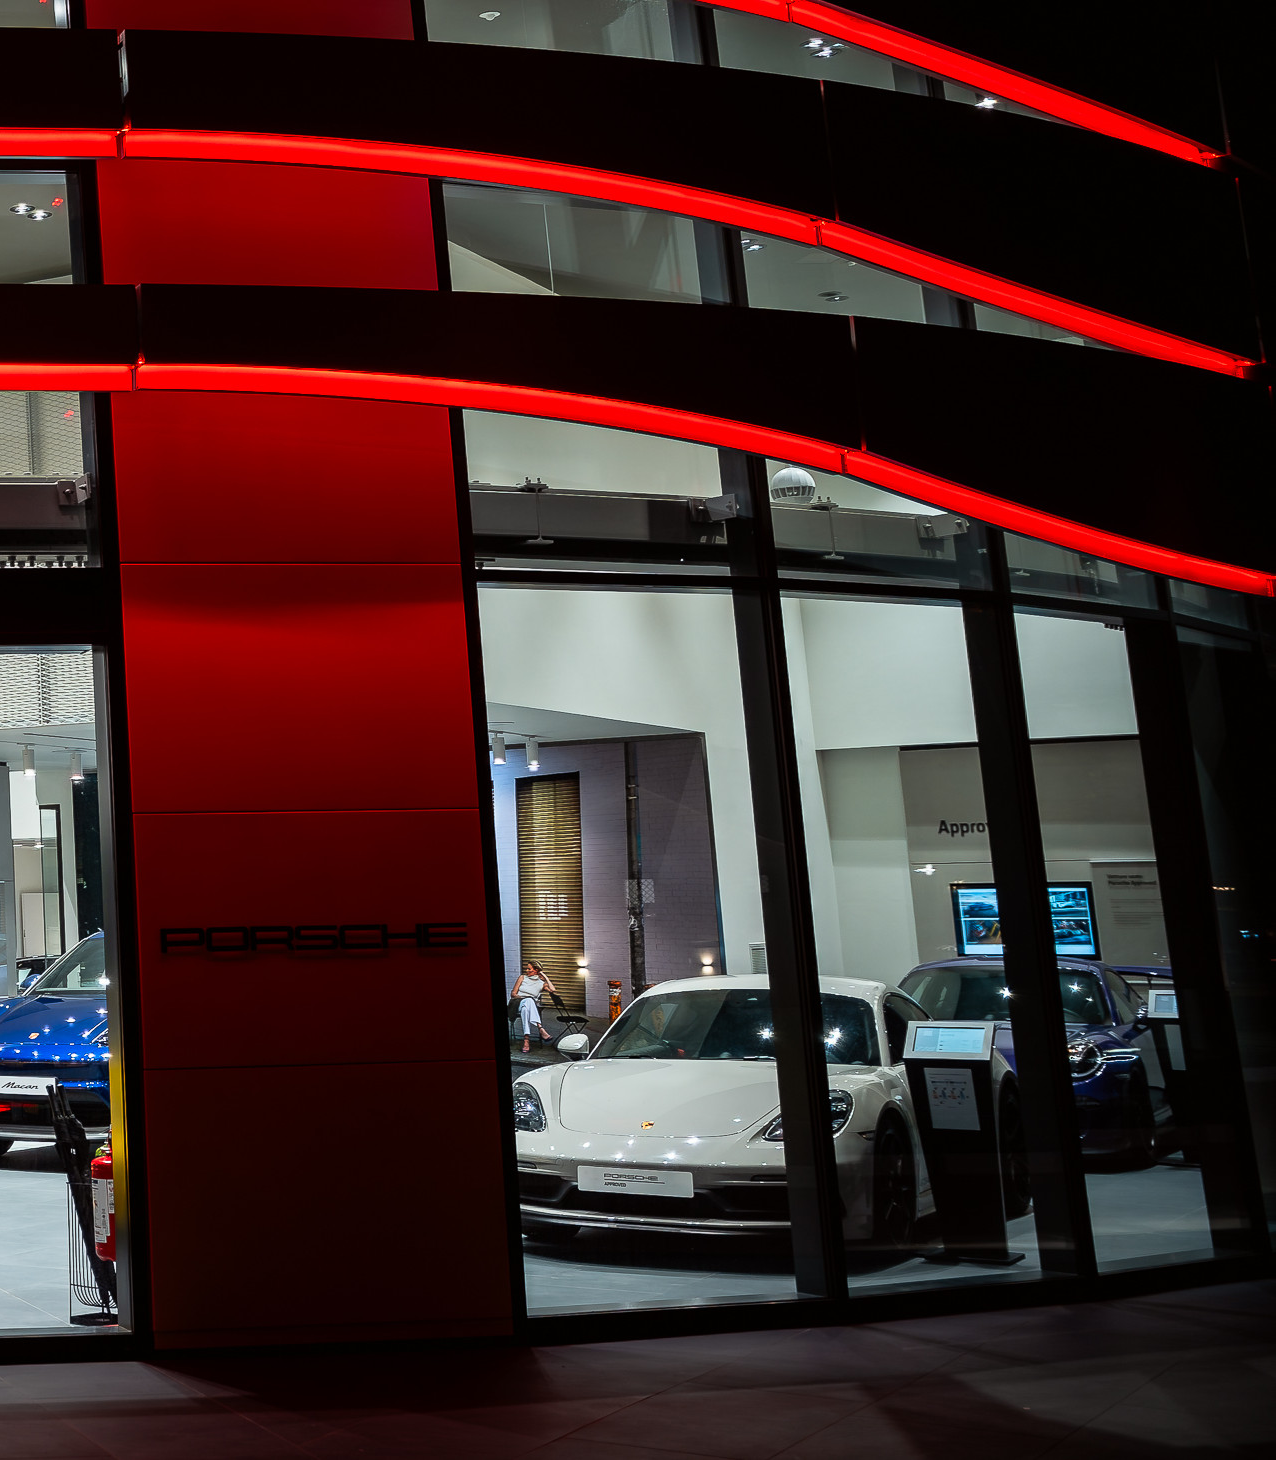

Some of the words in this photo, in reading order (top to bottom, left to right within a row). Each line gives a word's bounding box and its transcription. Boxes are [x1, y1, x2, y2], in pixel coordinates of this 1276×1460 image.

[160, 922, 469, 954] PORSCHE
[1, 1081, 39, 1090] Macan
[603, 1173, 659, 1181] PORSCHE
